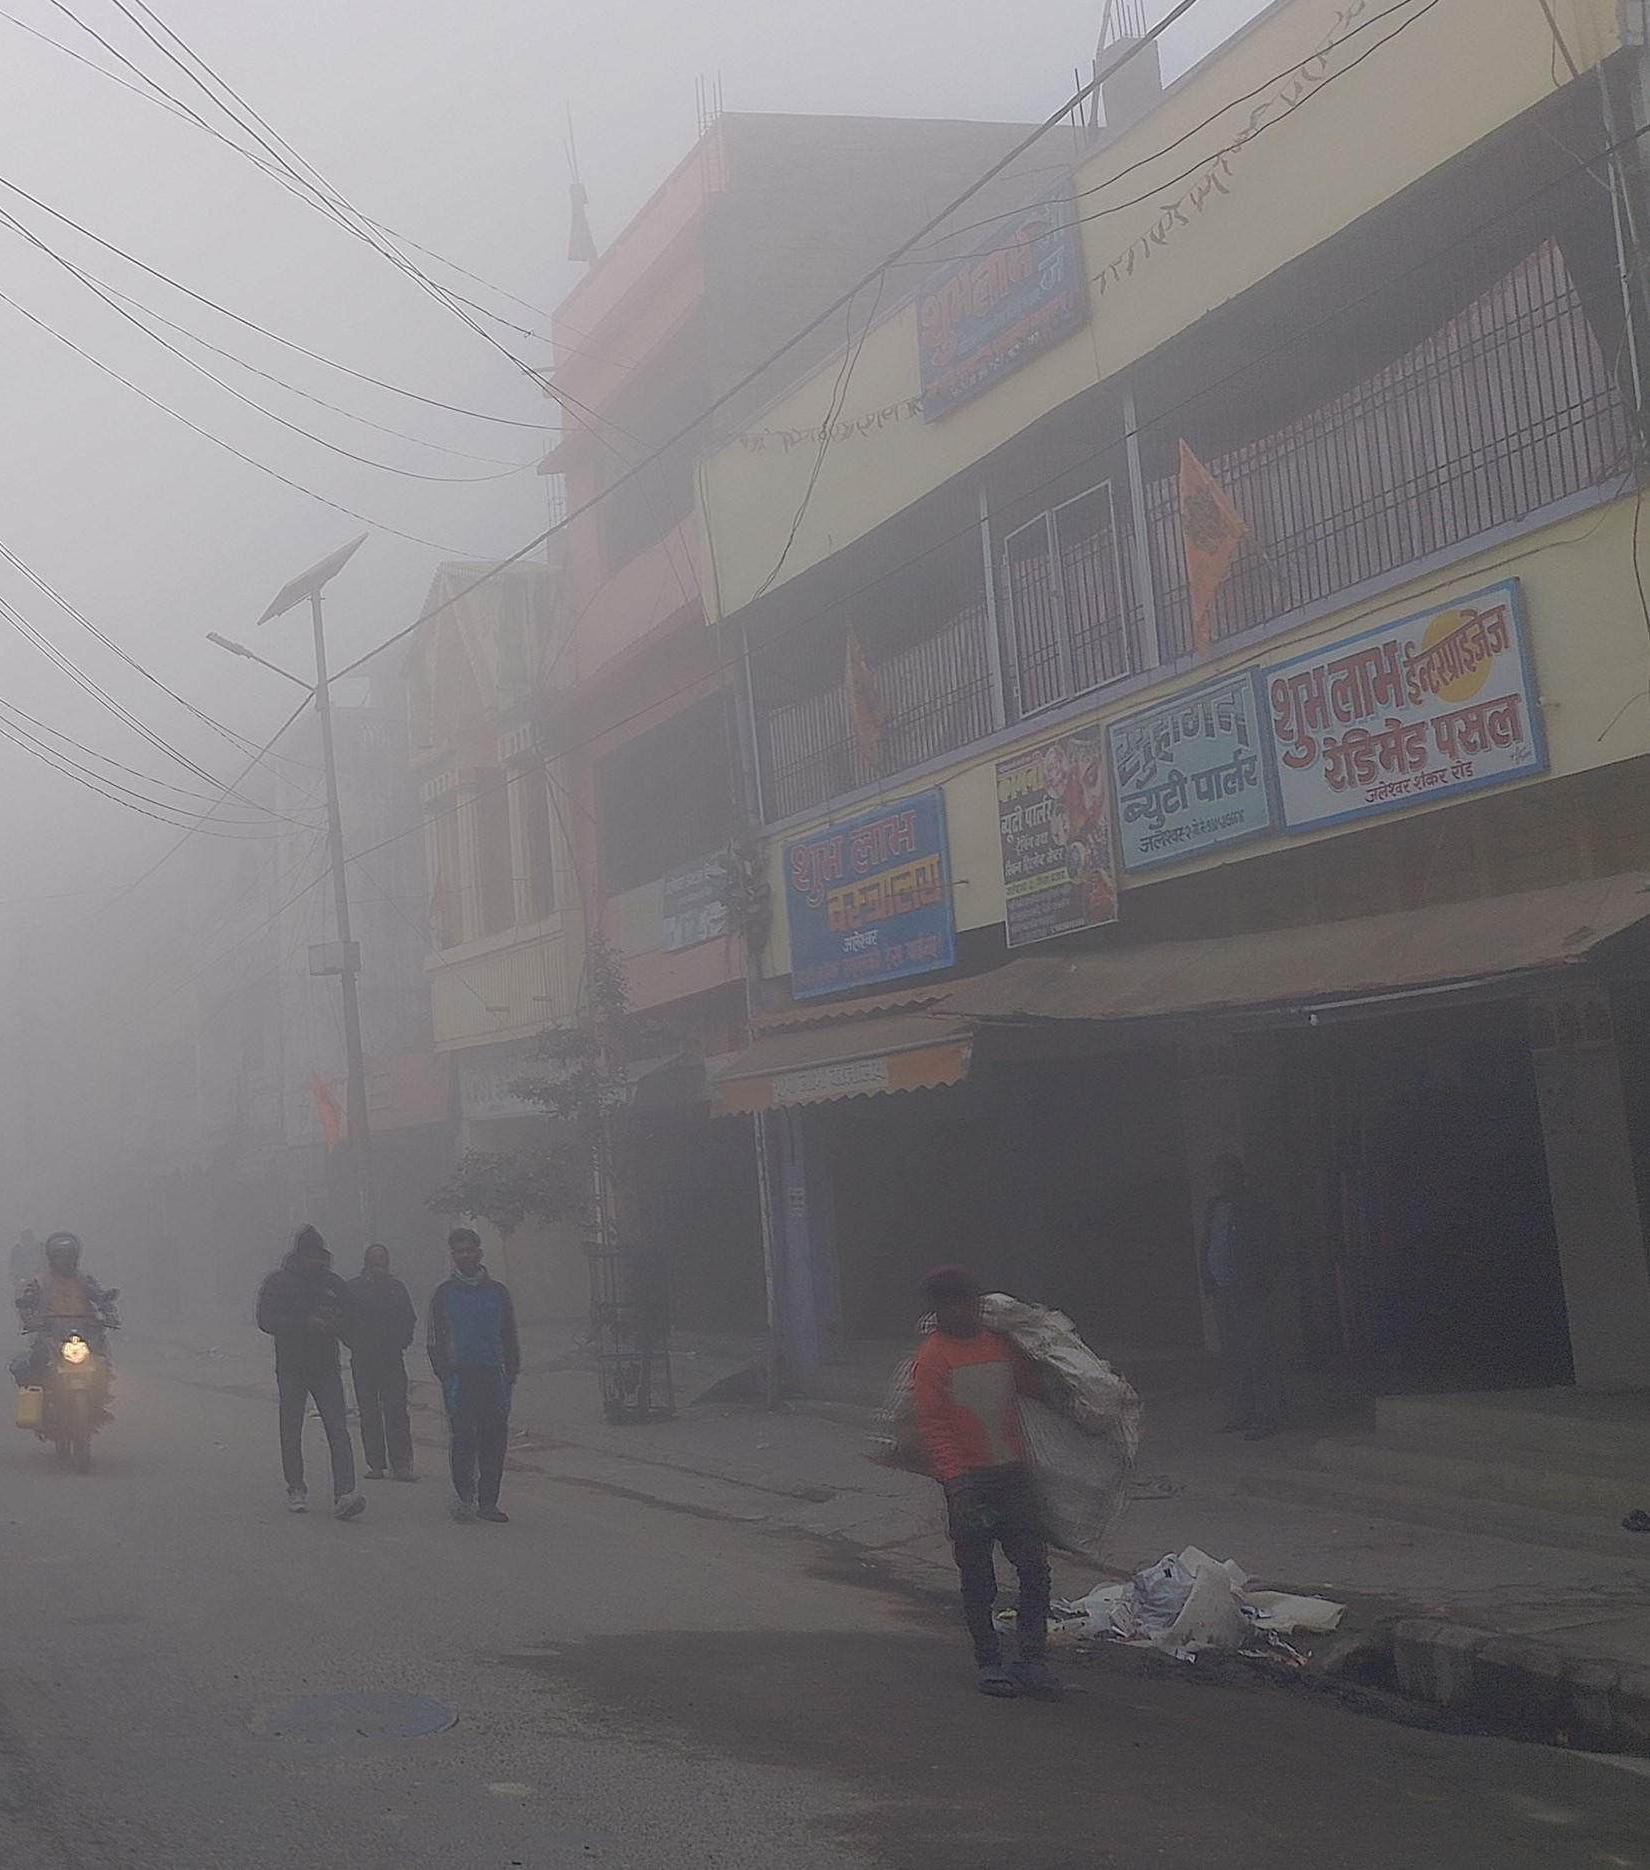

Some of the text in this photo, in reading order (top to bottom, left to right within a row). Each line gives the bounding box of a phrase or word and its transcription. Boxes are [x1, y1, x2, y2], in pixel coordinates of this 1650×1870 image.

[1271, 666, 1329, 769] शुभ
[1328, 640, 1405, 724] लाभ
[1323, 693, 1521, 791] रेडिमेड पसल
[1025, 795, 1053, 827] पार्लर
[1191, 748, 1258, 803] पार्लर
[1366, 762, 1474, 803] जलेश्वर शंकर रोड
[791, 836, 843, 908] शुभ
[847, 810, 917, 874] लाभ
